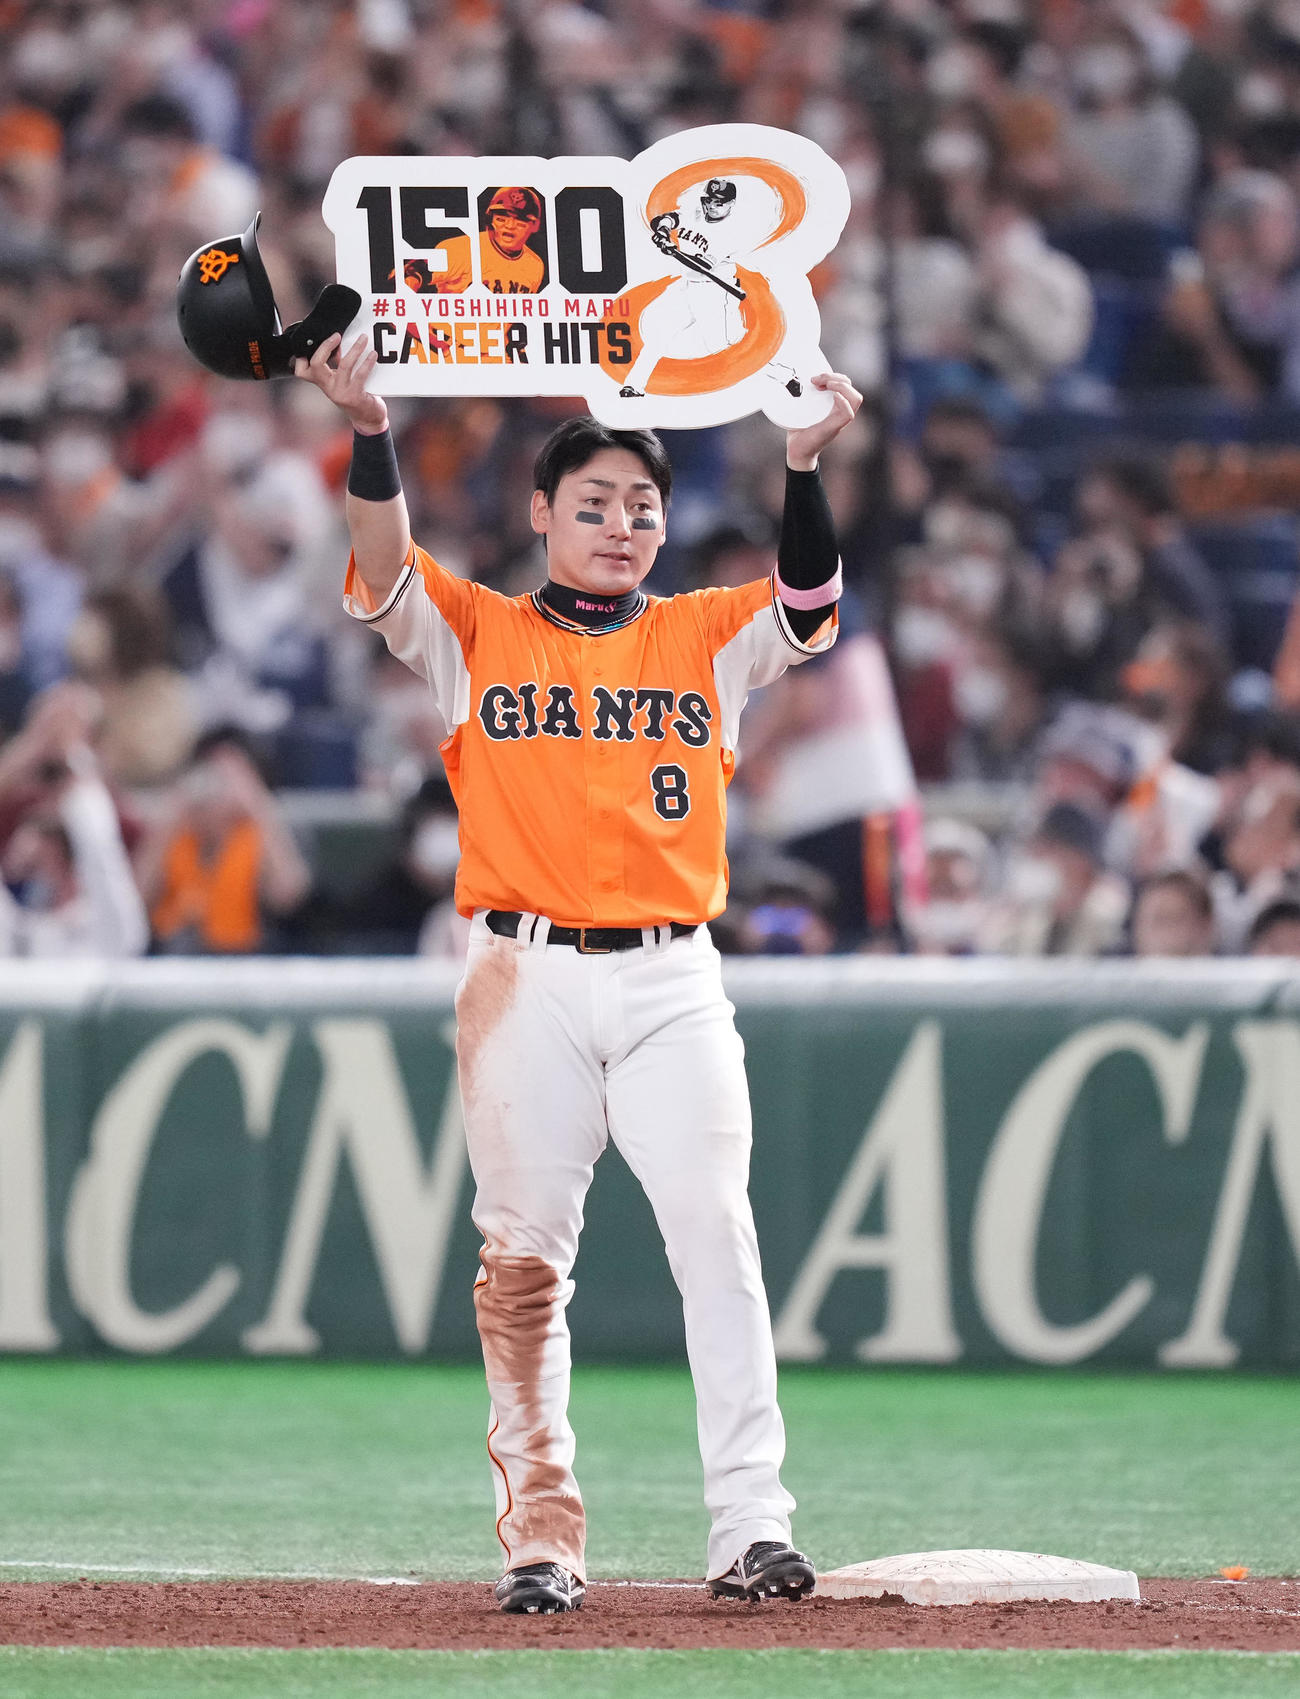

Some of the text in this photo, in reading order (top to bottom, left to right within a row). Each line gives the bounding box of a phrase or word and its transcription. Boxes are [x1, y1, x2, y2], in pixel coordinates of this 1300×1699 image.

[356, 186, 628, 294] 1500
[372, 298, 631, 318] #8 YOSHIHIRO MARU
[373, 322, 632, 365] CAREER HITS
[575, 599, 604, 612] Maru
[477, 681, 713, 748] GIANTS
[650, 763, 691, 821] 8
